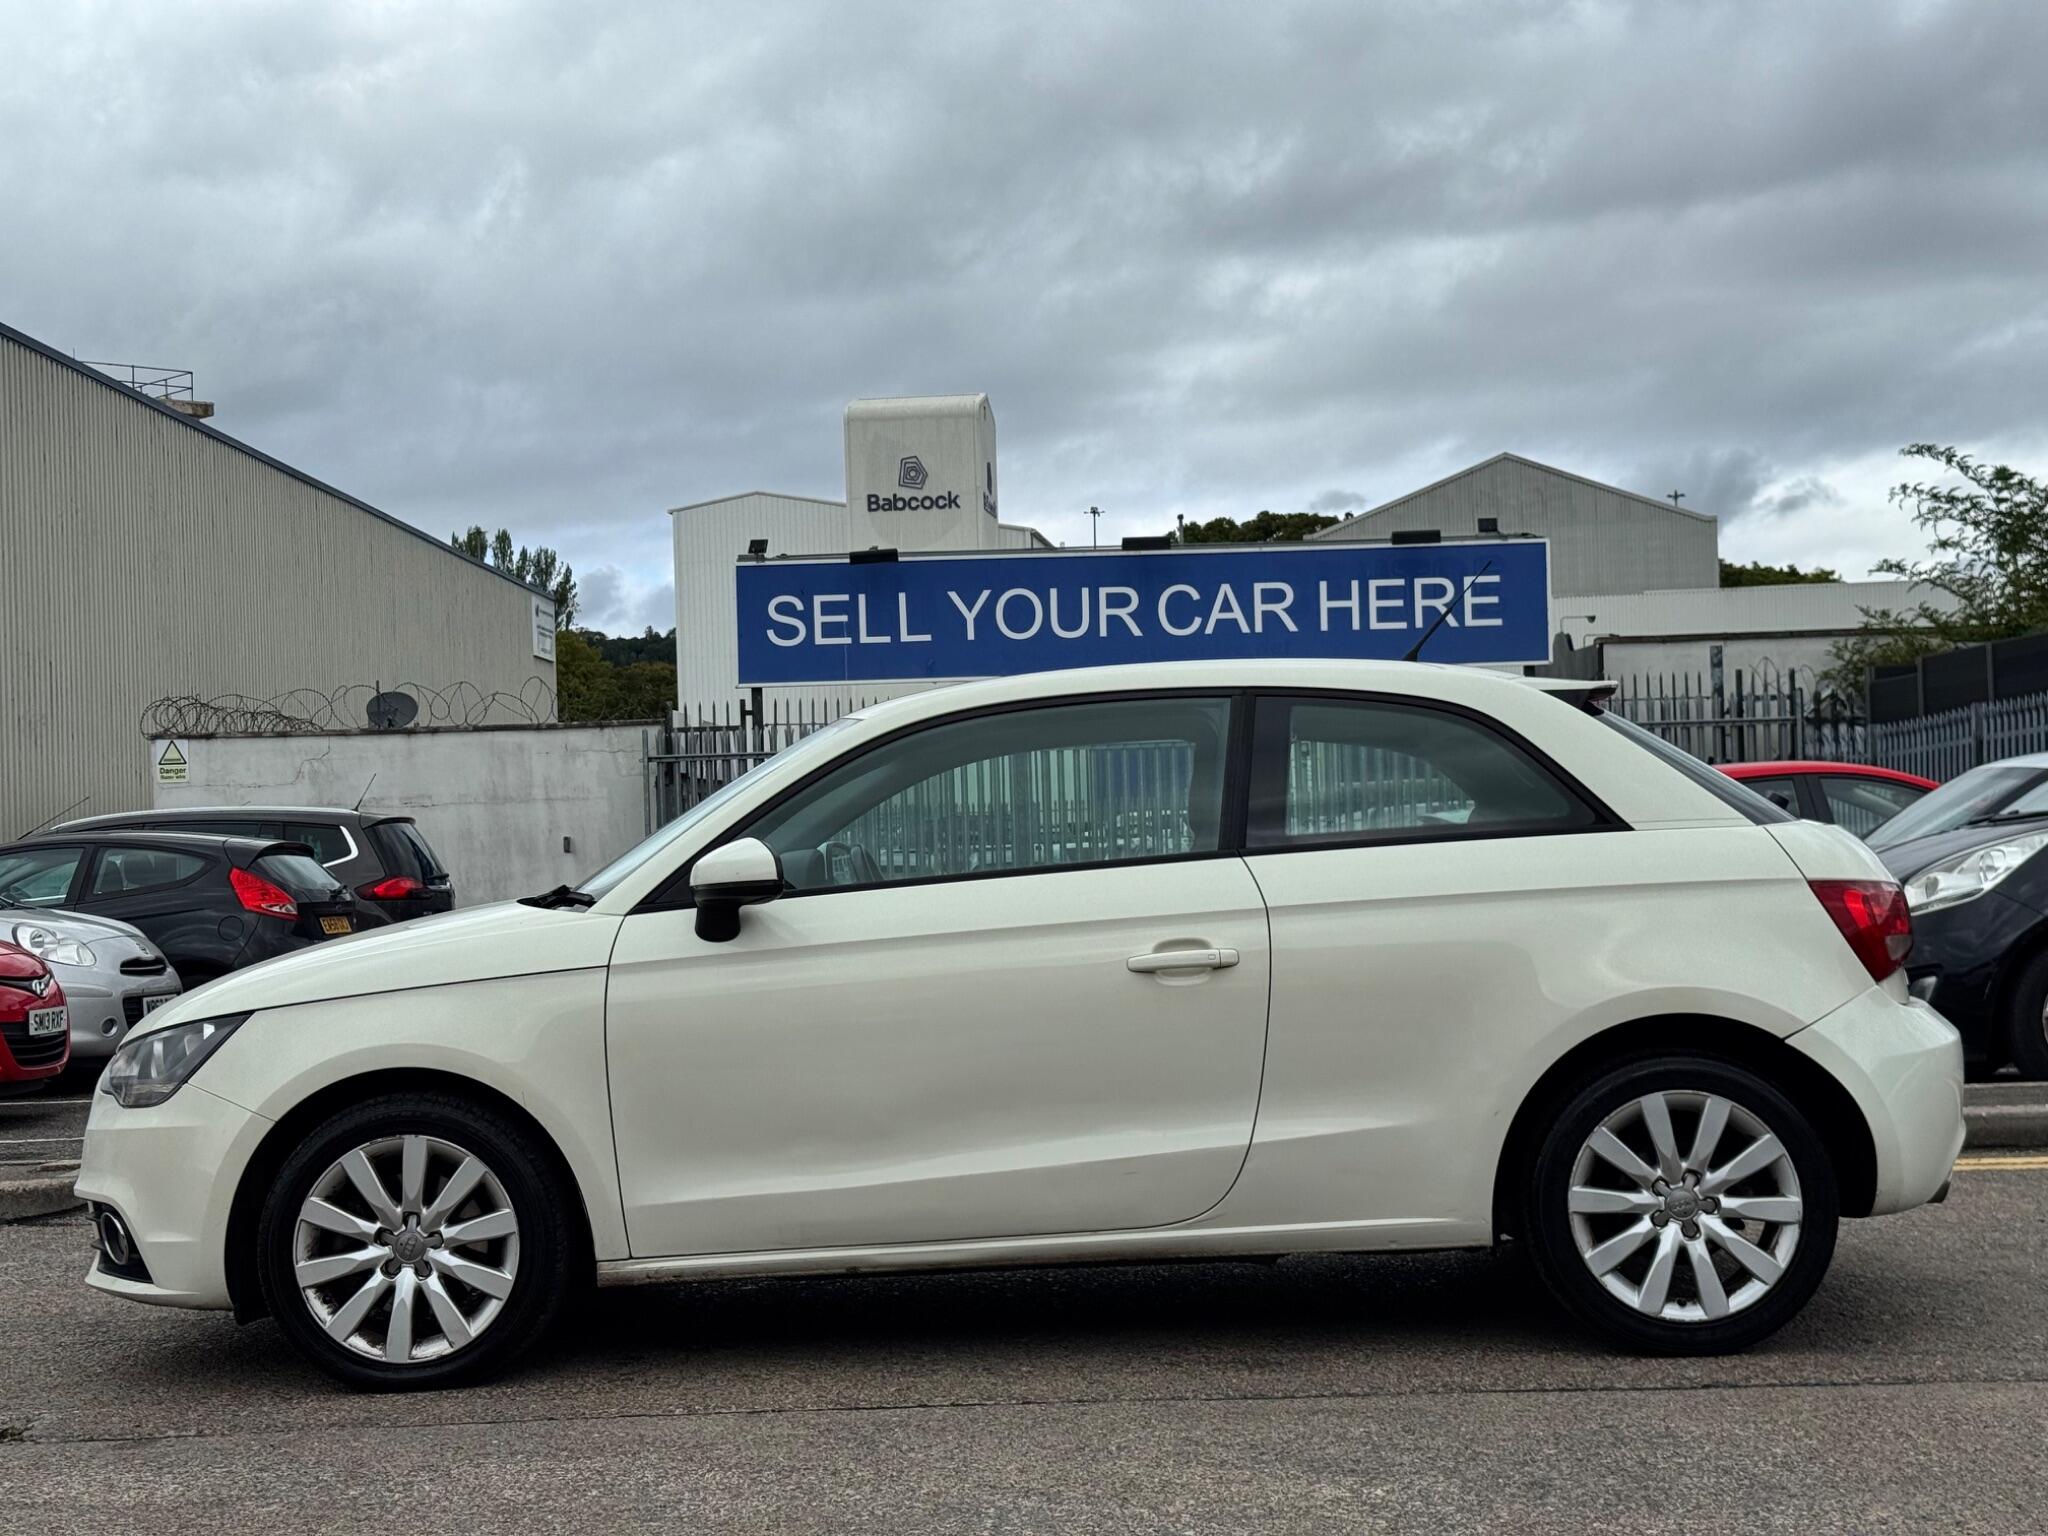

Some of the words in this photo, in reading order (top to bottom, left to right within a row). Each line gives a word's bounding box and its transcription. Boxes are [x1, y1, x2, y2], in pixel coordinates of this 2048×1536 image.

[867, 491, 960, 512] Babcock
[767, 593, 931, 646] SELL
[948, 587, 1142, 640] YOUR
[1158, 583, 1297, 635] CAR
[1320, 576, 1502, 631] HERE
[159, 767, 187, 775] Danger
[33, 1012, 50, 1031] SM13
[52, 1010, 64, 1028] RXF
